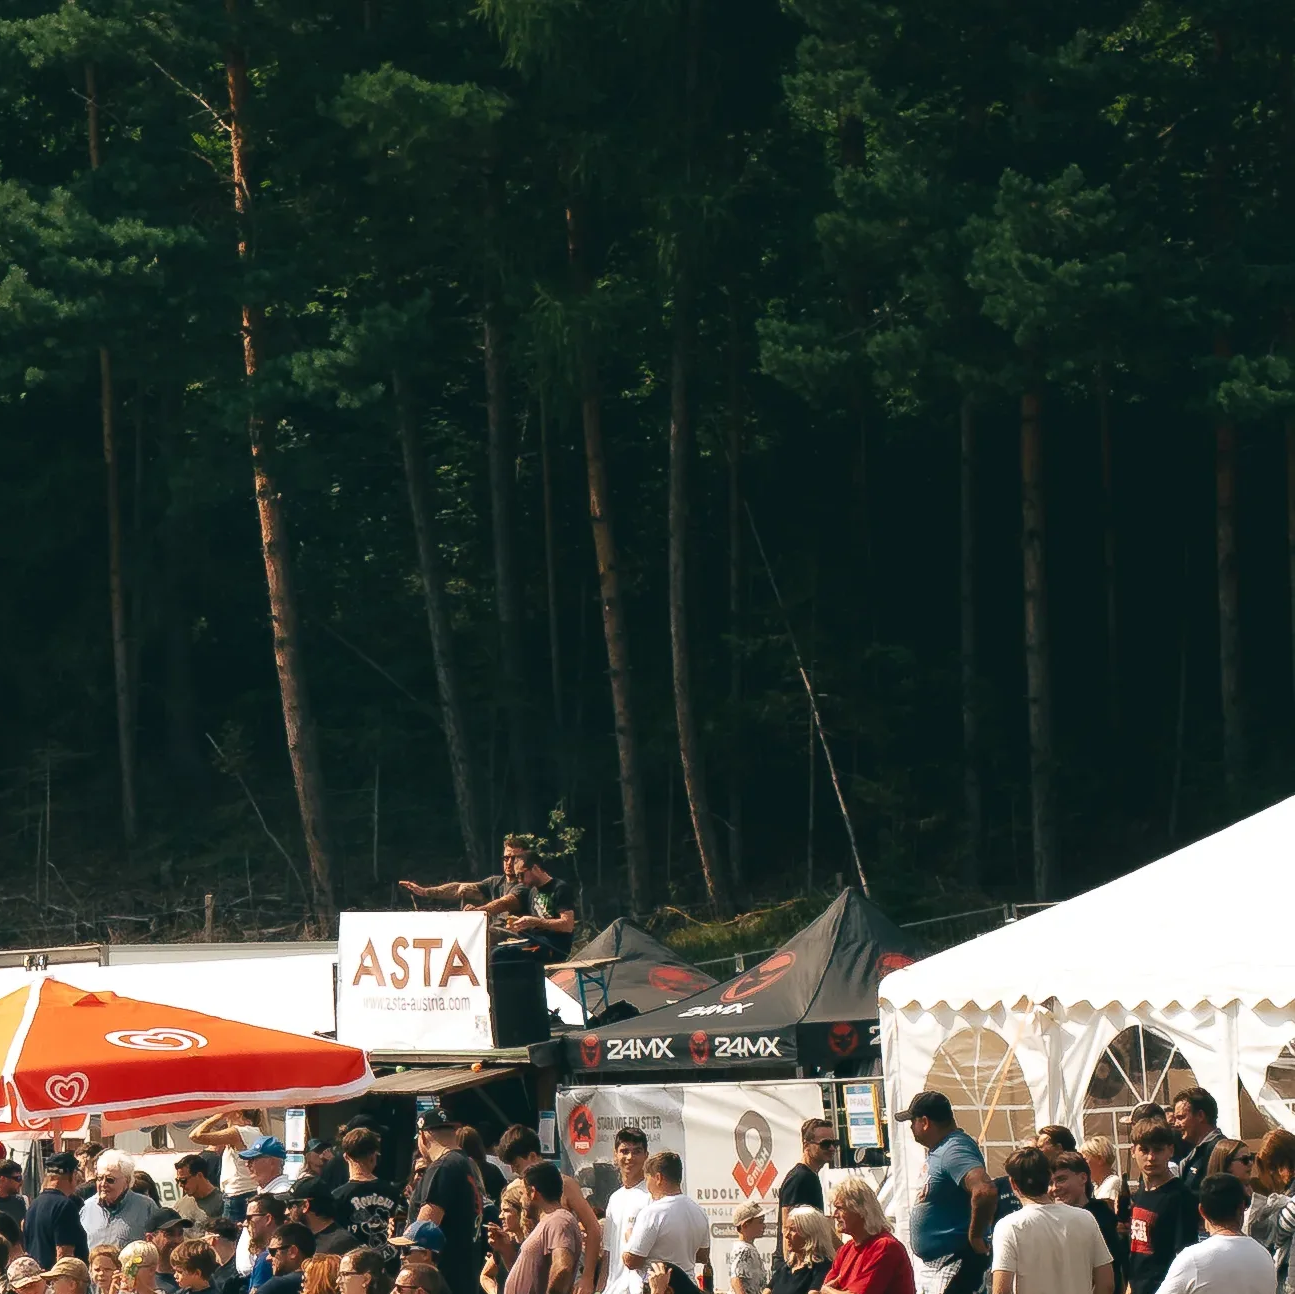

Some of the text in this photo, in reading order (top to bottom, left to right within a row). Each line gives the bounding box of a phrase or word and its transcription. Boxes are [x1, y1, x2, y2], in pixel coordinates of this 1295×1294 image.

[352, 936, 481, 990] ASTA
[606, 1037, 675, 1060] 24MX
[714, 1036, 782, 1058] 24MX
[641, 1116, 661, 1129] STIER
[747, 1147, 770, 1187] GmbH
[697, 1188, 740, 1200] RUDOLF
